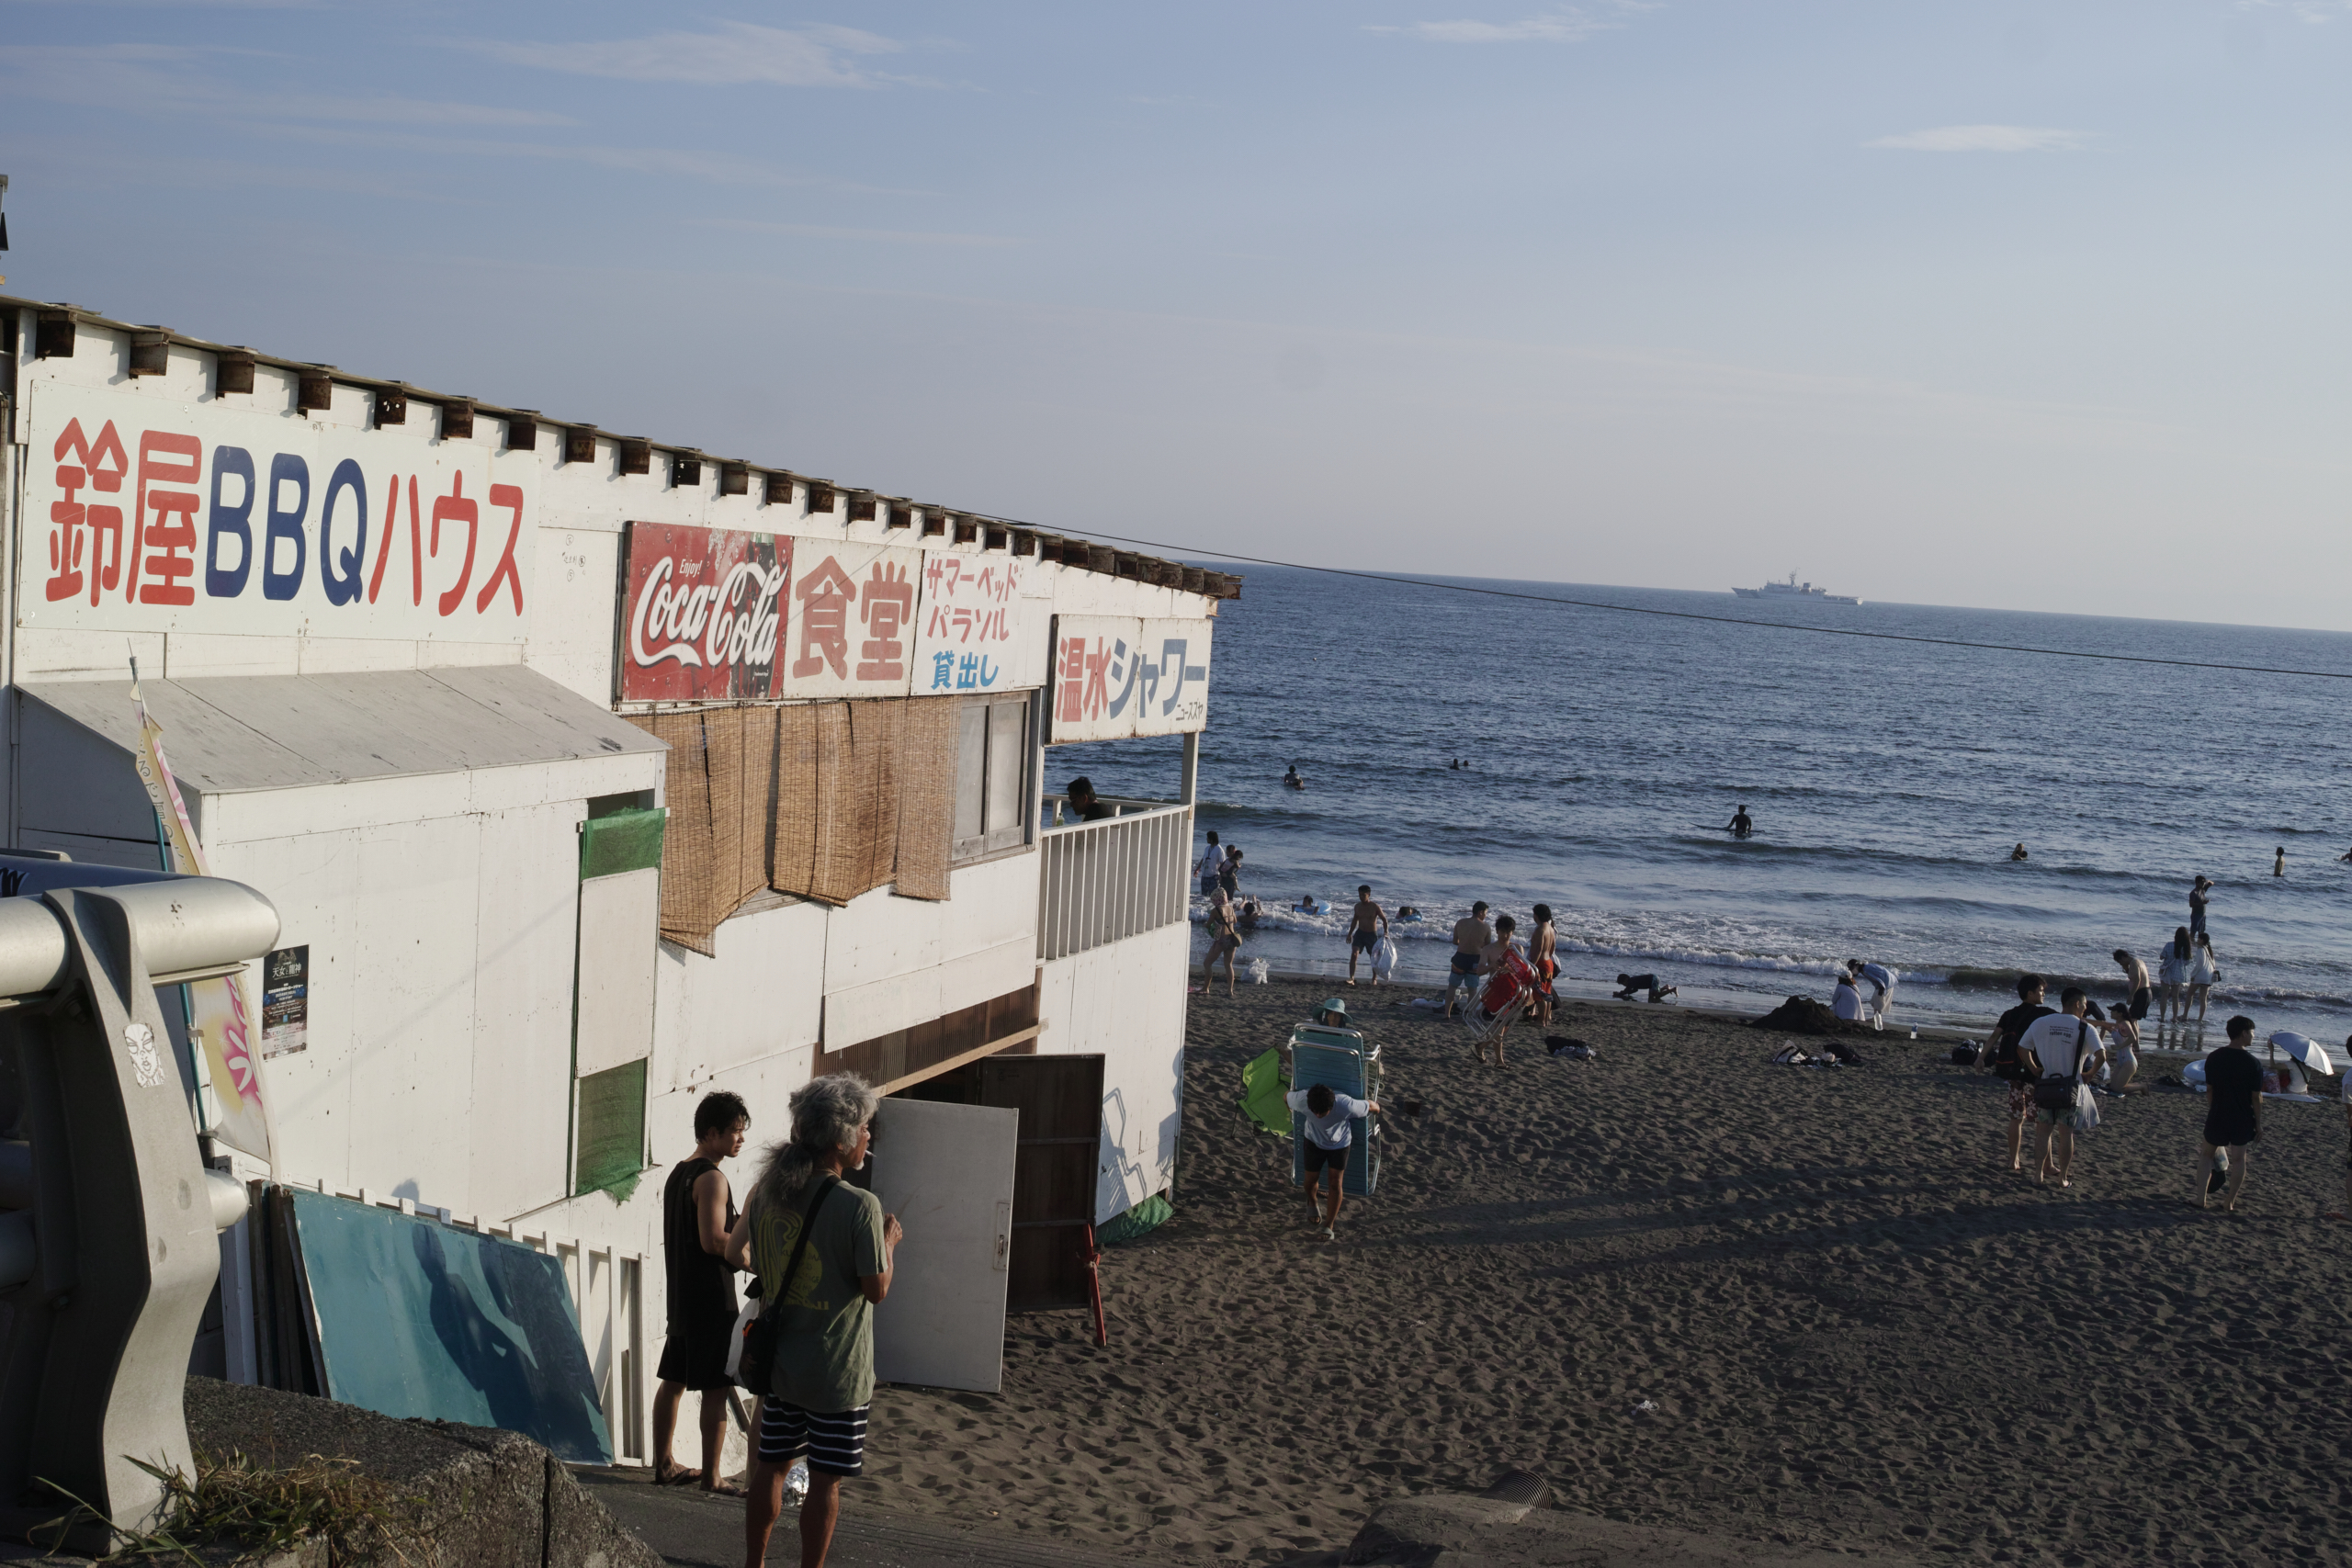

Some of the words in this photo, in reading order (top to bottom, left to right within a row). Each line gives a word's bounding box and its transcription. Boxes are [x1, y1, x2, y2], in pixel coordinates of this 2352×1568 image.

[46, 417, 523, 616] 鈴屋BBQハウス
[679, 558, 703, 578] Enjoy!
[927, 558, 1019, 603] サマーベッド
[631, 556, 787, 667] Coca-Cola
[792, 555, 913, 681] 食堂
[927, 604, 1010, 643] パラソル
[931, 649, 1000, 690] 貸出し
[1055, 637, 1206, 723] 温水シャワー
